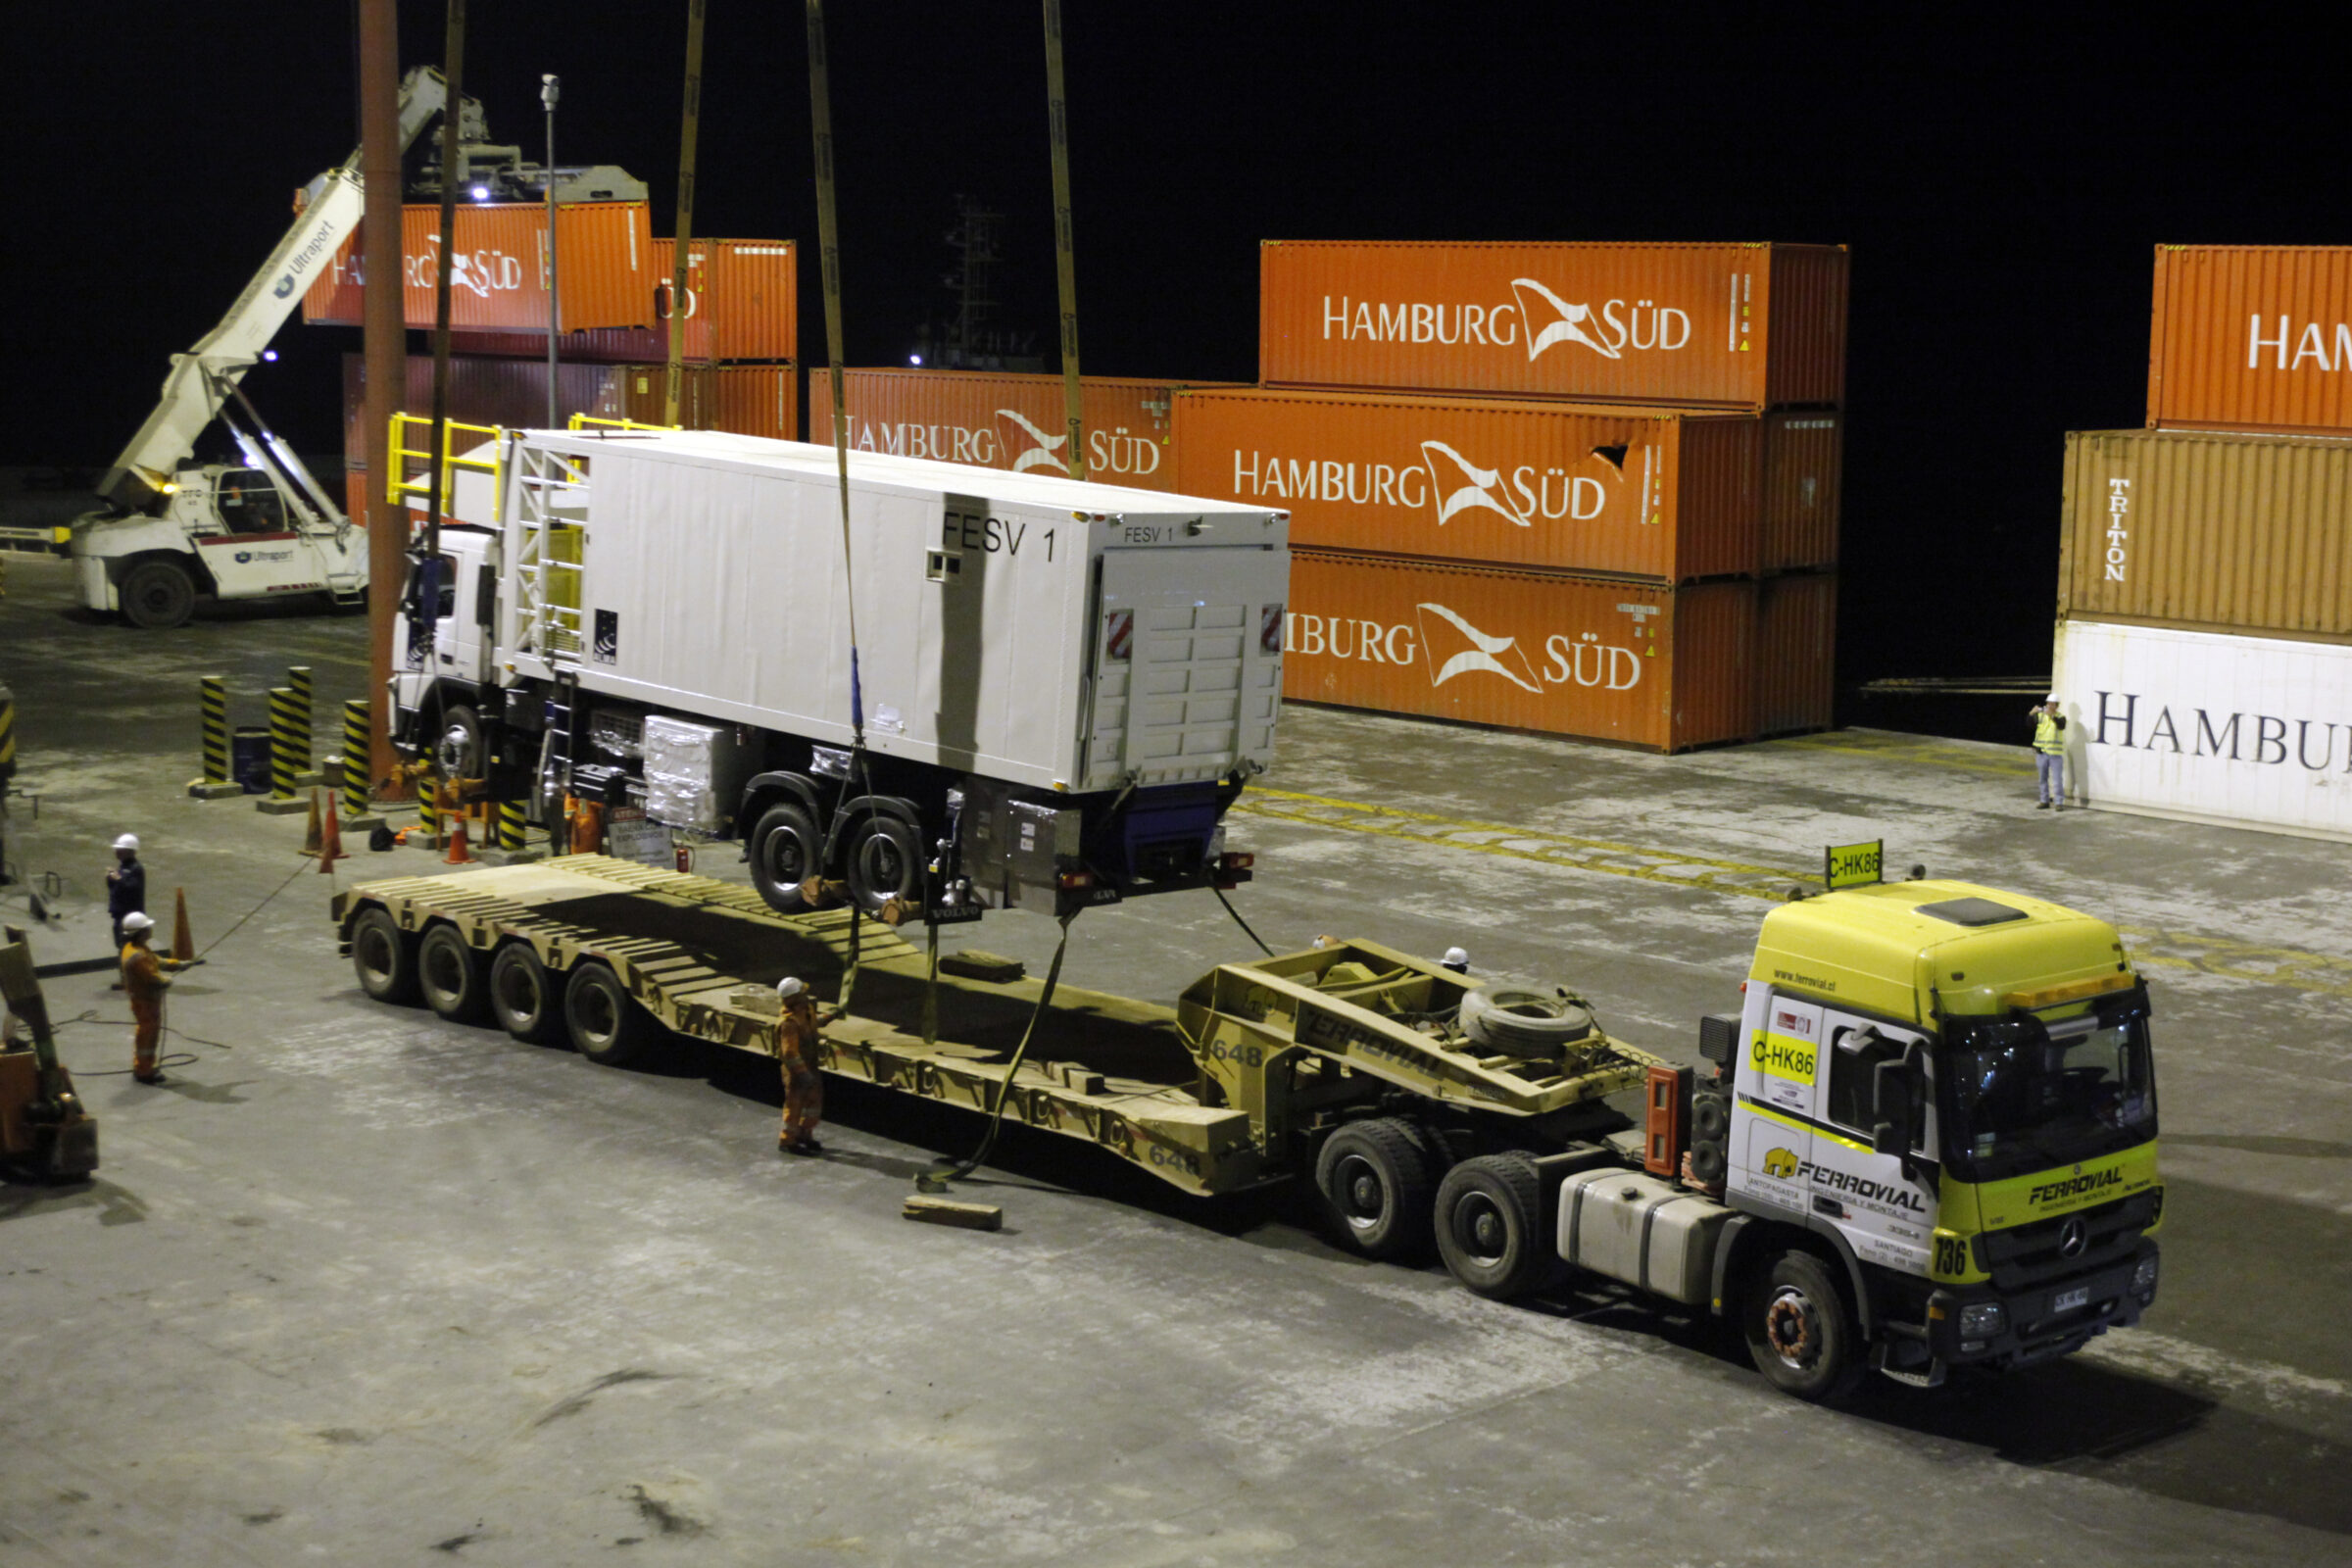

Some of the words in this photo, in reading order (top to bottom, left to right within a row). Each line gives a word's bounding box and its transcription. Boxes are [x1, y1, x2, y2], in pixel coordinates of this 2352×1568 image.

[287, 219, 336, 276] Ultraport
[474, 250, 521, 290] SÜD
[1323, 295, 1516, 347] HAMBURG
[1603, 298, 1691, 351] SÜD
[1089, 426, 1160, 475] SÜD
[1234, 449, 1426, 509] HAMBURG
[1512, 466, 1606, 521] SÜD
[943, 511, 1026, 557] FESV
[1044, 527, 1055, 563] 1
[1124, 526, 1161, 544] FESV
[1167, 527, 1174, 542] 1
[2104, 477, 2131, 582] TRITON
[1544, 632, 1642, 691] SÜD
[1829, 852, 1881, 879] C-HK86
[931, 906, 979, 920] VOLVO
[1773, 968, 1837, 993] www.ferrovial.cl
[1211, 1038, 1263, 1068] 648
[1752, 1040, 1815, 1076] C-HK86
[1797, 1160, 1927, 1213] FERROVIAL
[2029, 1165, 2124, 1205] FERROVIAL
[1866, 1200, 1909, 1221] MONTAJE
[1874, 1239, 1913, 1257] SANTIAGO
[1935, 1236, 1969, 1276] 736
